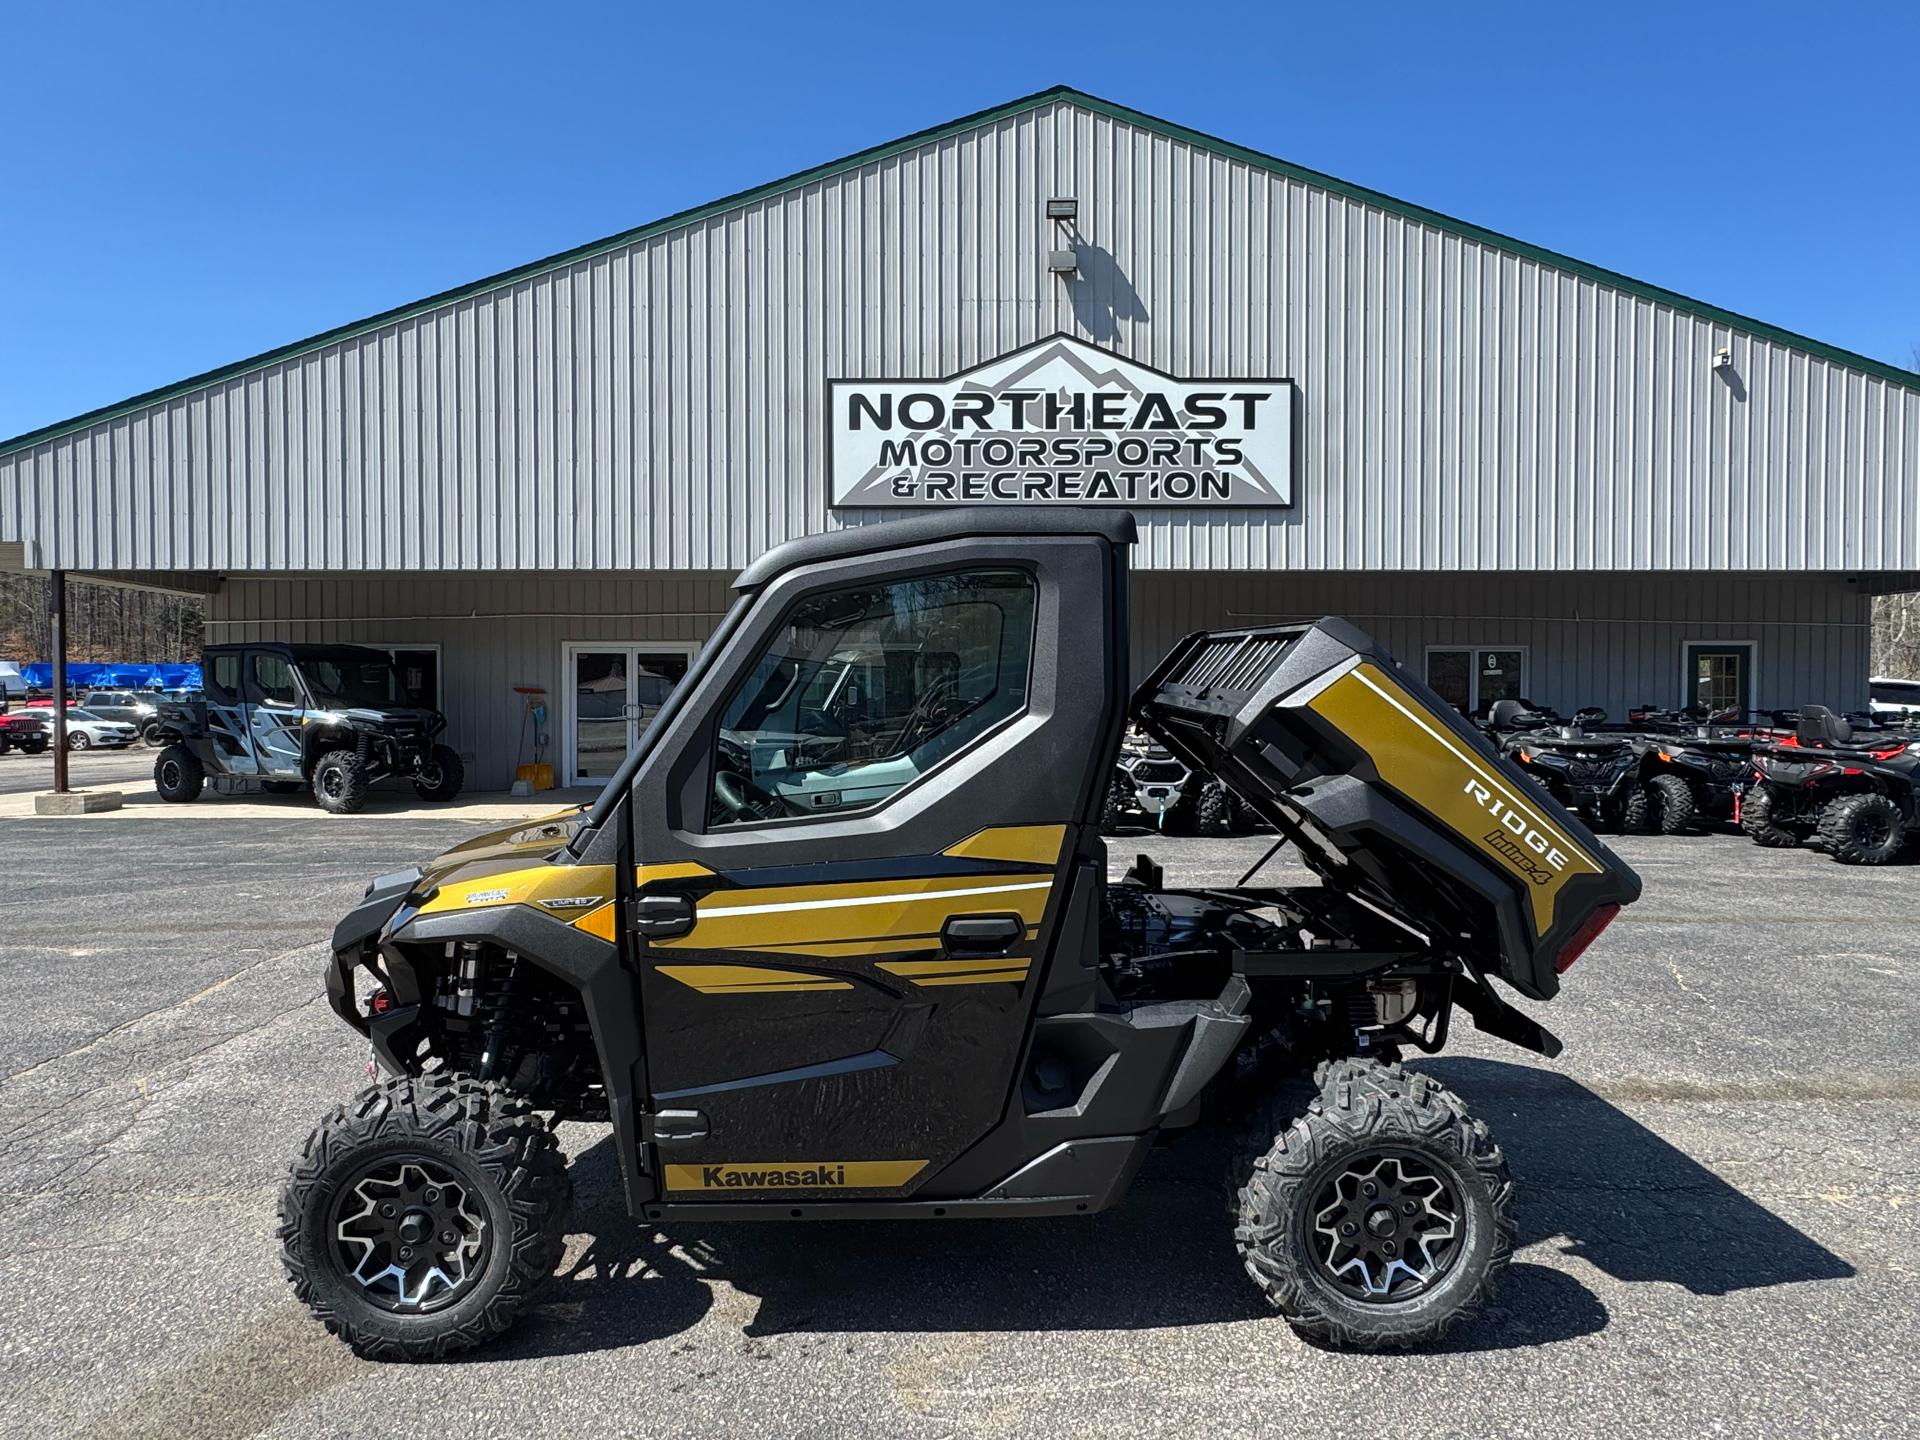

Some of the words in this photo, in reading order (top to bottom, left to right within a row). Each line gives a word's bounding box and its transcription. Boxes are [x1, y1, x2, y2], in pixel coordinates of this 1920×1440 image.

[848, 392, 1273, 431] NORTHEAST
[878, 438, 1244, 467] MOTORSPORTS
[1464, 779, 1569, 871] RIDGE
[703, 1165, 845, 1187] Kawasaki
